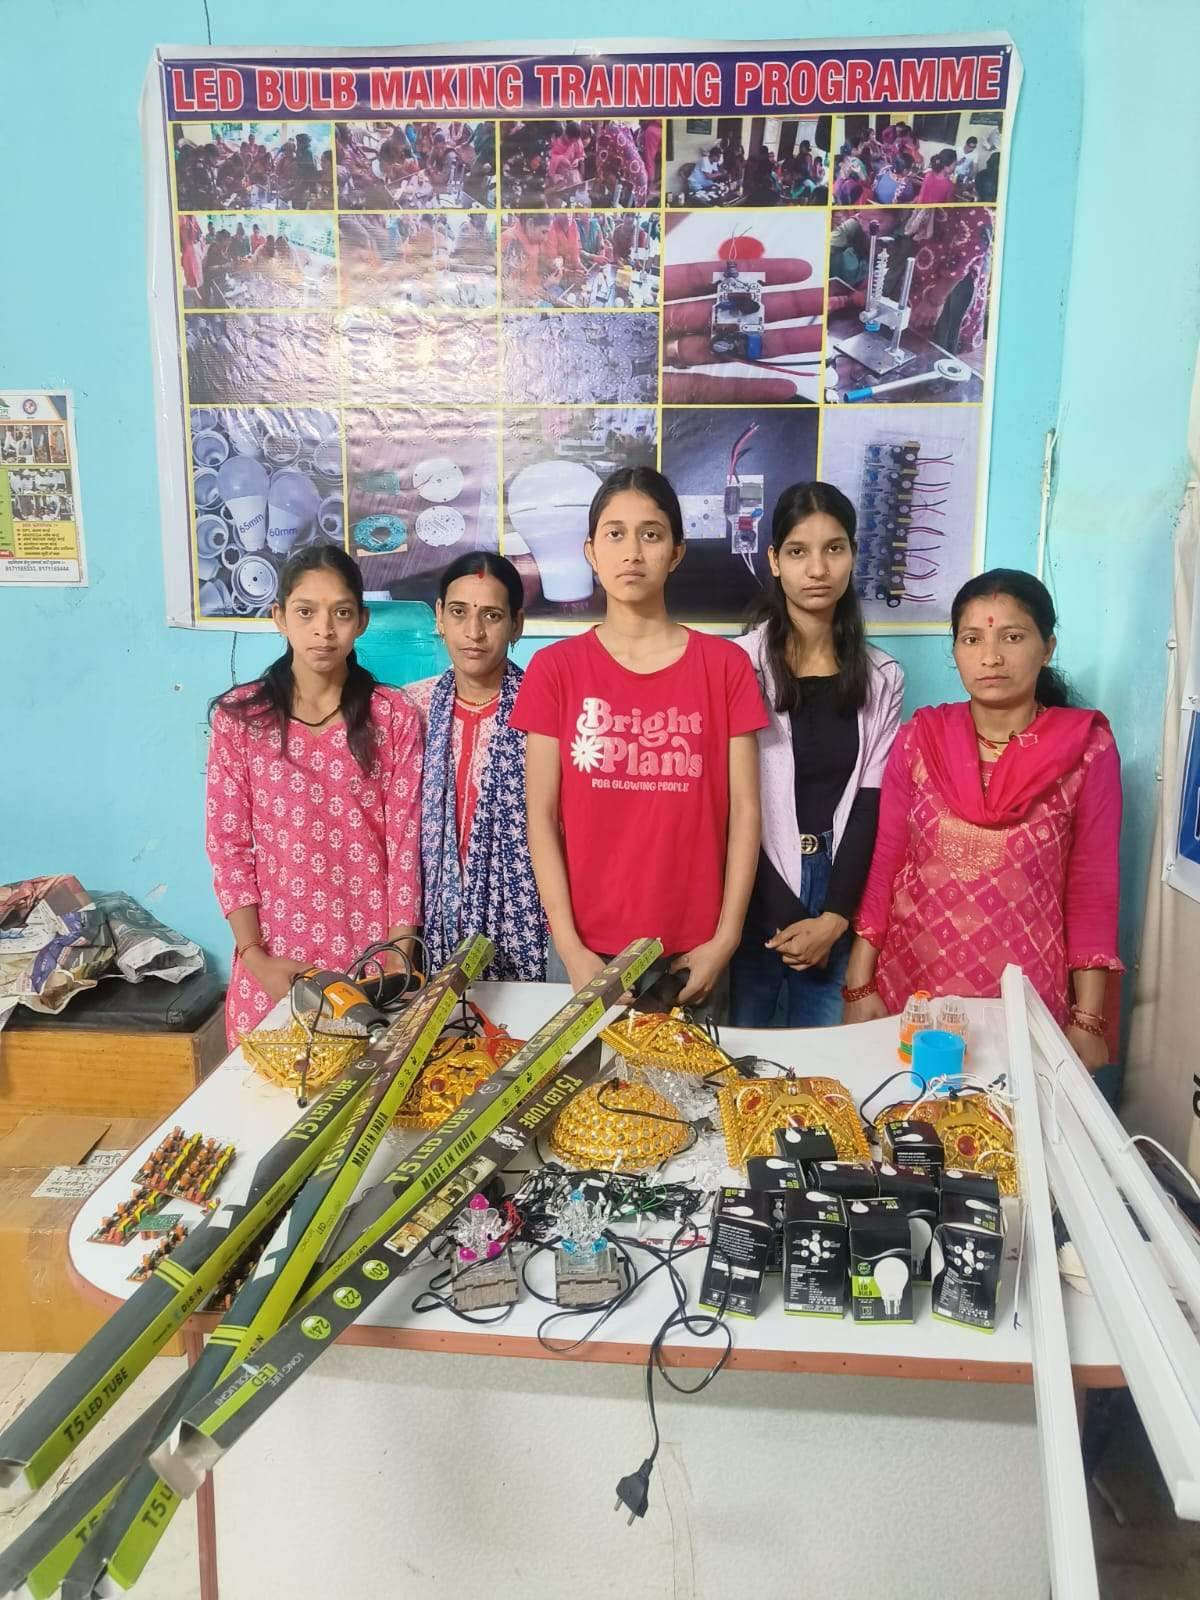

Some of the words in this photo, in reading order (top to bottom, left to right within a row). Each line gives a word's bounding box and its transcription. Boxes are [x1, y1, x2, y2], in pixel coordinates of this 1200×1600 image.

[172, 67, 244, 112] LED
[256, 66, 358, 112] BULB
[370, 64, 523, 111] MAKING
[535, 62, 722, 110] TRAINING
[735, 55, 1002, 107] PROGRAMME
[240, 513, 265, 534] 65mm
[269, 527, 298, 537] 60mm
[576, 697, 703, 748] Bright
[592, 778, 611, 789] FOR
[612, 779, 657, 792] GLOWING
[658, 781, 690, 793] PEOPLE
[543, 1086, 568, 1106] LED
[555, 1073, 584, 1094] T5
[284, 1121, 319, 1141] T5
[306, 1102, 333, 1121] LED
[325, 1079, 358, 1101] TUBE
[370, 1111, 389, 1136] INDIA
[518, 1103, 552, 1130] TUBE
[365, 1132, 377, 1146] IN
[383, 1161, 422, 1184] T5
[411, 1137, 443, 1160] LED
[436, 1107, 476, 1135] TUBE
[351, 1142, 371, 1169] MADE
[420, 1162, 446, 1192] MADE
[443, 1151, 456, 1167] IN
[454, 1129, 478, 1157] INDIA
[251, 1365, 275, 1387] LED
[62, 1415, 86, 1444] T5
[83, 1397, 103, 1422] LED
[101, 1366, 129, 1399] TUBE
[141, 1498, 167, 1529] T5
